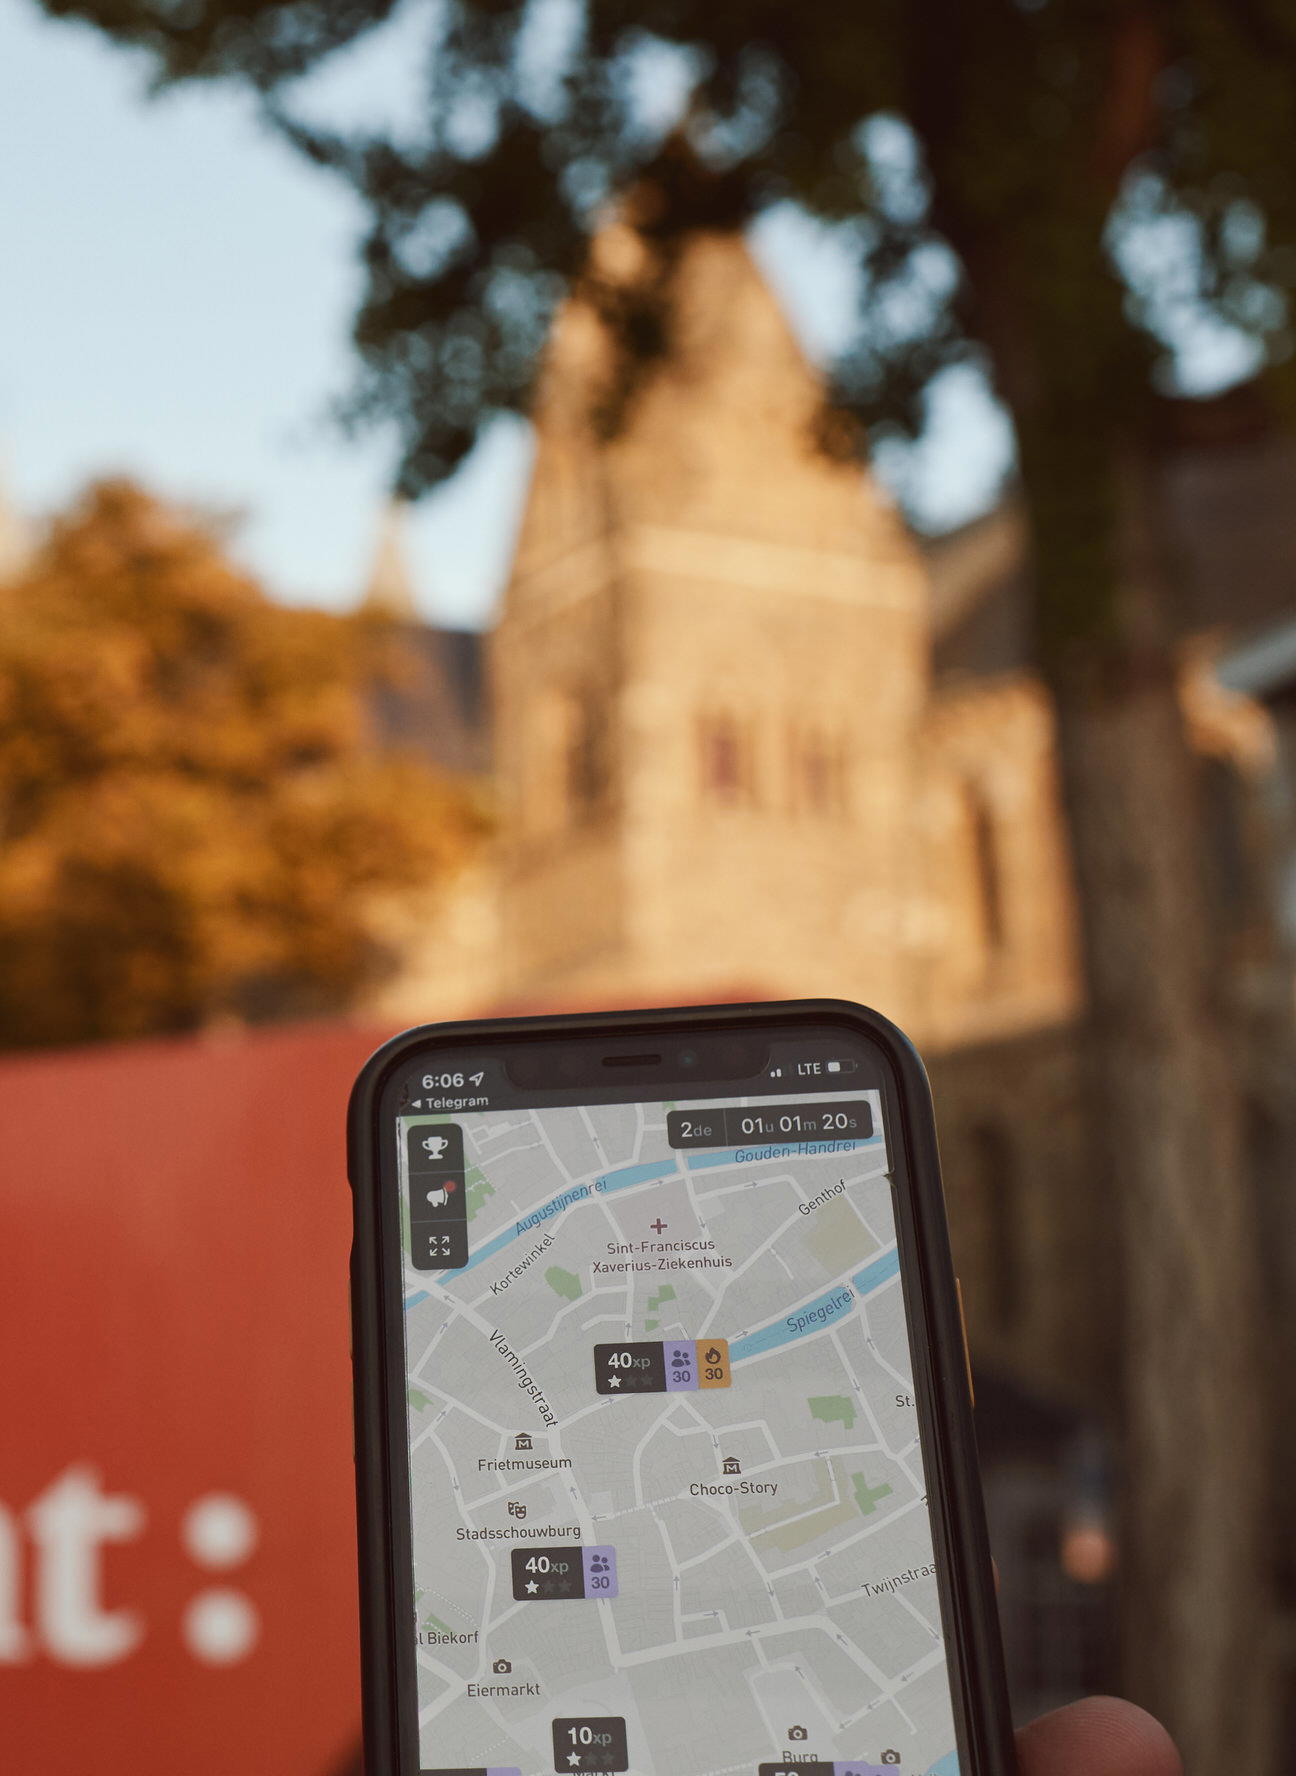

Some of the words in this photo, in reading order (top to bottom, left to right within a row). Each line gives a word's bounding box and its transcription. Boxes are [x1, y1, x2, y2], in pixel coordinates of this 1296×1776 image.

[797, 1063, 822, 1076] LTE
[422, 1072, 464, 1089] 6:06
[426, 1095, 489, 1110] Telegram
[735, 1141, 856, 1164] Gouden-Handrei
[798, 1178, 847, 1217] Genthof
[514, 1179, 608, 1236] Augustijnenrei
[607, 1239, 716, 1255] Sint-Franciscus
[489, 1233, 556, 1296] Kortewinkel
[592, 1256, 733, 1274] Xaverius-Ziekenhuis
[786, 1284, 855, 1333] Spiegelrei
[488, 1328, 559, 1428] Vlamingstraat
[672, 1370, 691, 1383] 30
[705, 1367, 724, 1381] 30
[895, 1394, 915, 1408] St.
[478, 1457, 573, 1472] Frietmuseum
[689, 1481, 778, 1497] Choco-Story
[456, 1525, 581, 1541] Stadsschouwburg
[591, 1576, 610, 1590] 30
[427, 1630, 479, 1645] Biekorf
[467, 1683, 541, 1698] Eiermarkt
